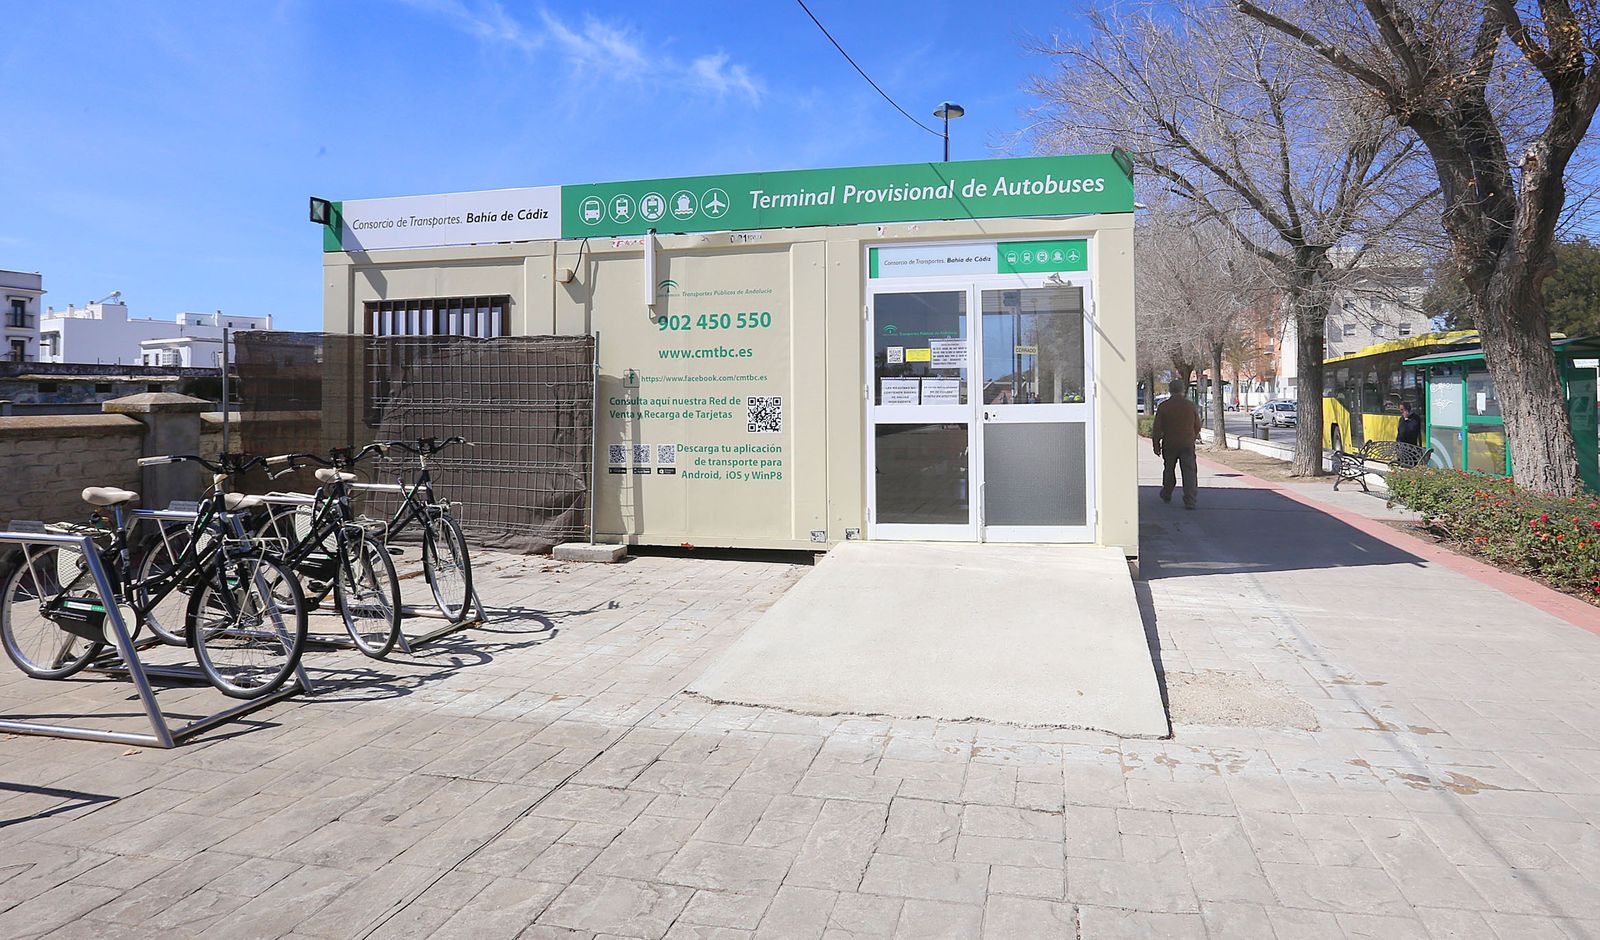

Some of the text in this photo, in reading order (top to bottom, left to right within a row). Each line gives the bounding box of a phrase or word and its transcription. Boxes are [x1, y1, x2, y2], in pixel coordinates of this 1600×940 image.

[749, 175, 1105, 209] Terminal Provisional de Autobuses
[352, 208, 549, 230] Consorcio de Transportes. Bahía de Cádiz
[658, 312, 772, 331] 902 450 550
[658, 346, 753, 359] www.cmtbc.es
[641, 374, 768, 383] https://www.facebook.com/cmtbc.es
[609, 396, 741, 408] Consulta aquí nuestra Red de
[609, 410, 733, 420] Venta y Recarga de Tarjetas
[677, 443, 782, 454] Descarga tu aplicación
[694, 457, 782, 467] de transporte para
[681, 471, 722, 480] Android,
[726, 471, 742, 480] iOS
[744, 473, 750, 482] y
[752, 470, 783, 480] WinP8
